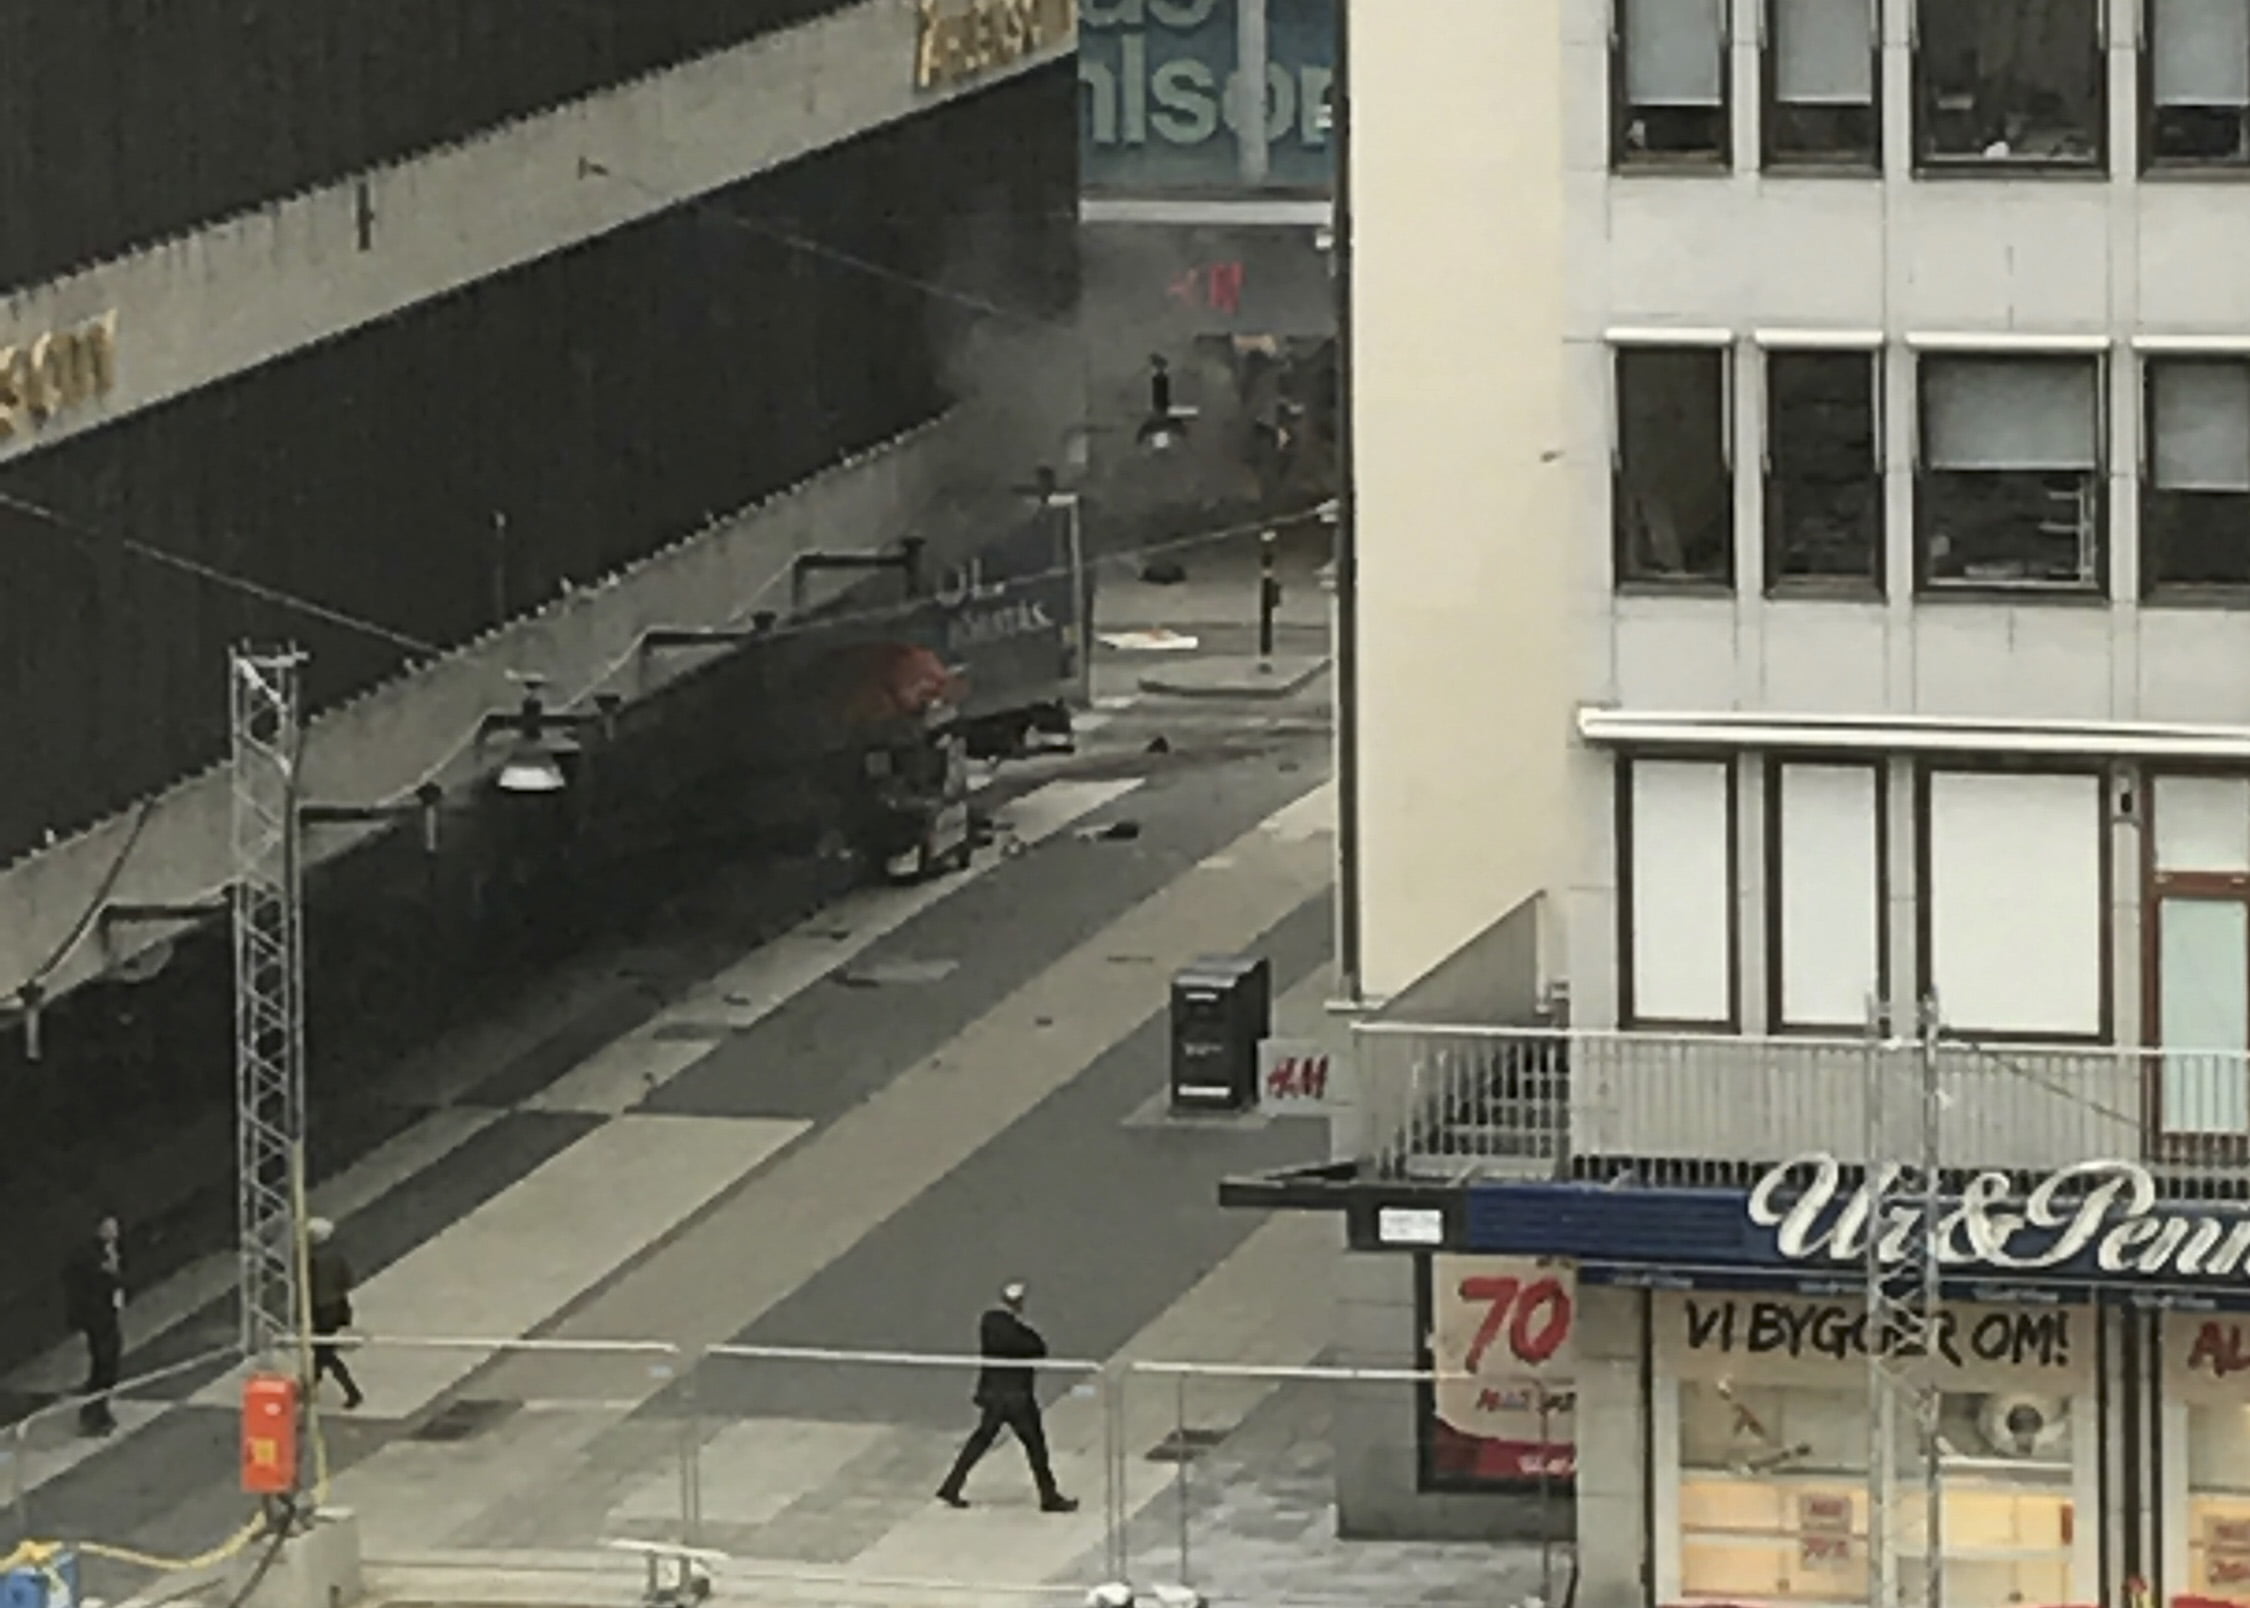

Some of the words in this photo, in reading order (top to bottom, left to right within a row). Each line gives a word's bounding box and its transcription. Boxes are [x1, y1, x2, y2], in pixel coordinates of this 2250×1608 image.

[1458, 1276, 1571, 1374] 70
[1686, 1301, 1735, 1352] VI
[1971, 1309, 2069, 1366] OM!
